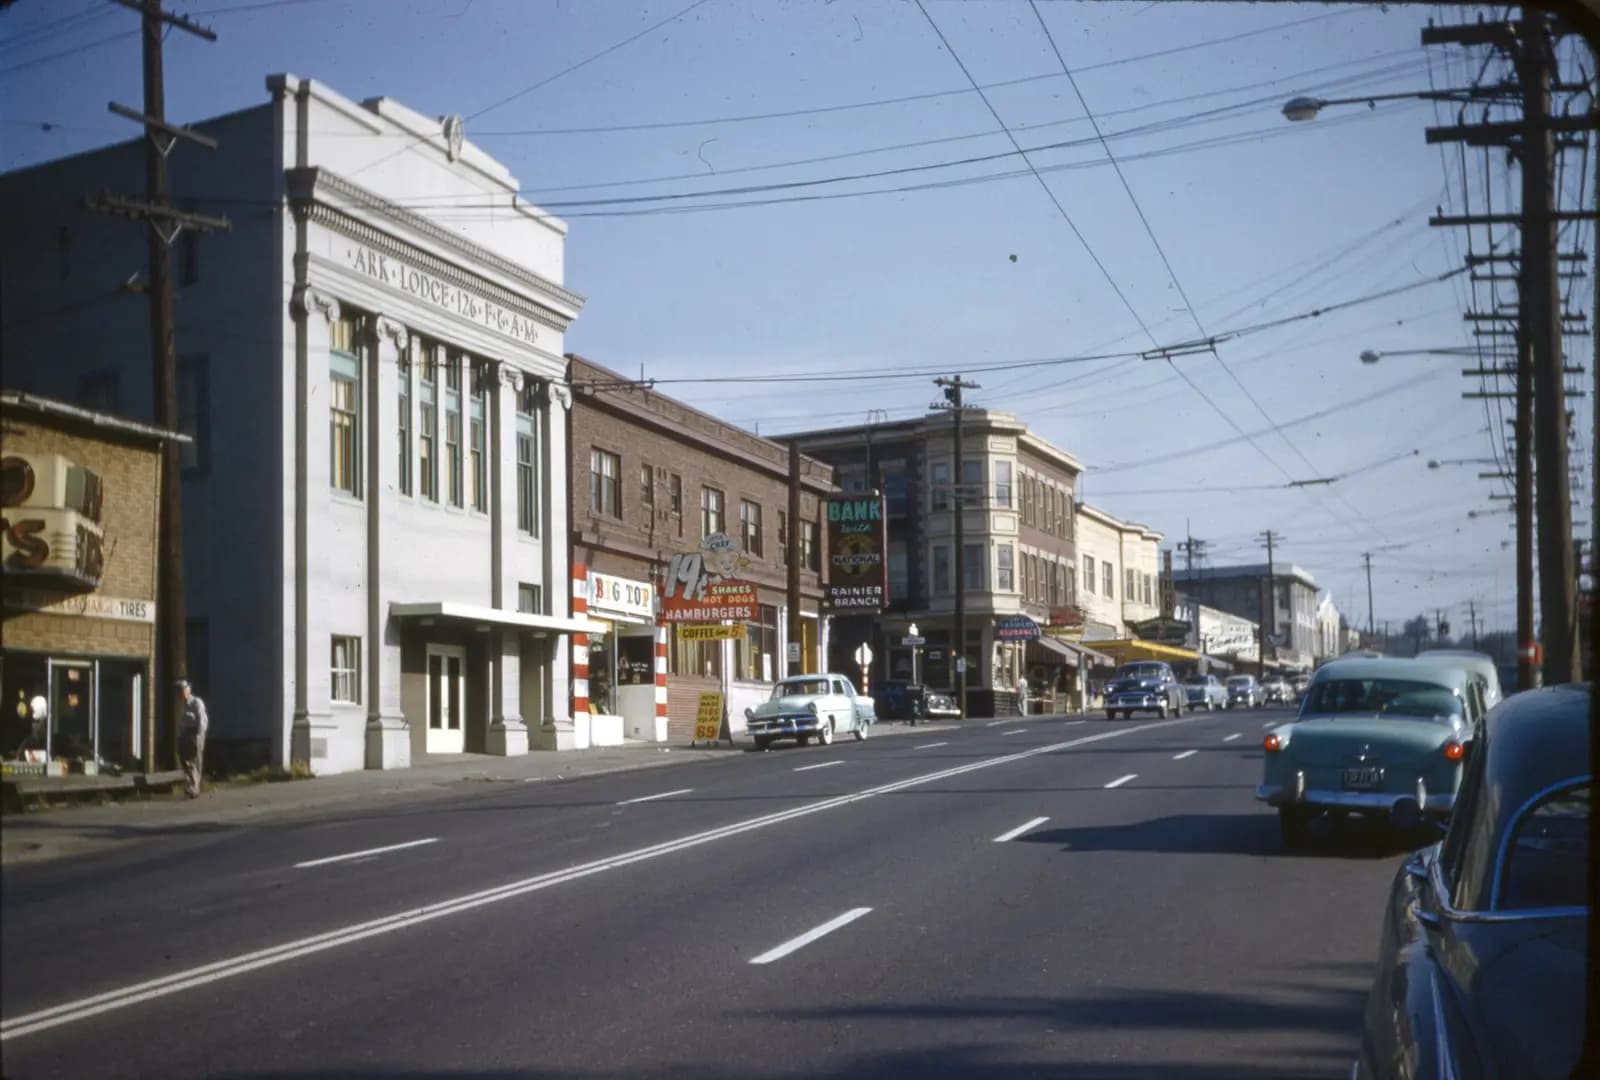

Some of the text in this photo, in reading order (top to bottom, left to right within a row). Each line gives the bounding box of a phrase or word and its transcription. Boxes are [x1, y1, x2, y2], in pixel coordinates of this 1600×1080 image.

[354, 246, 389, 283] ARK
[457, 290, 477, 318] 126
[829, 500, 881, 521] BANK
[595, 576, 649, 608] BIG TOP
[712, 585, 752, 595] SHAKES
[831, 586, 882, 596] RAINIER
[703, 594, 755, 605] HOT DOGS
[834, 597, 879, 607] BRANCH
[120, 602, 146, 618] TIRES
[666, 606, 752, 620] HAMBURGERS
[682, 628, 714, 639] COFFEE
